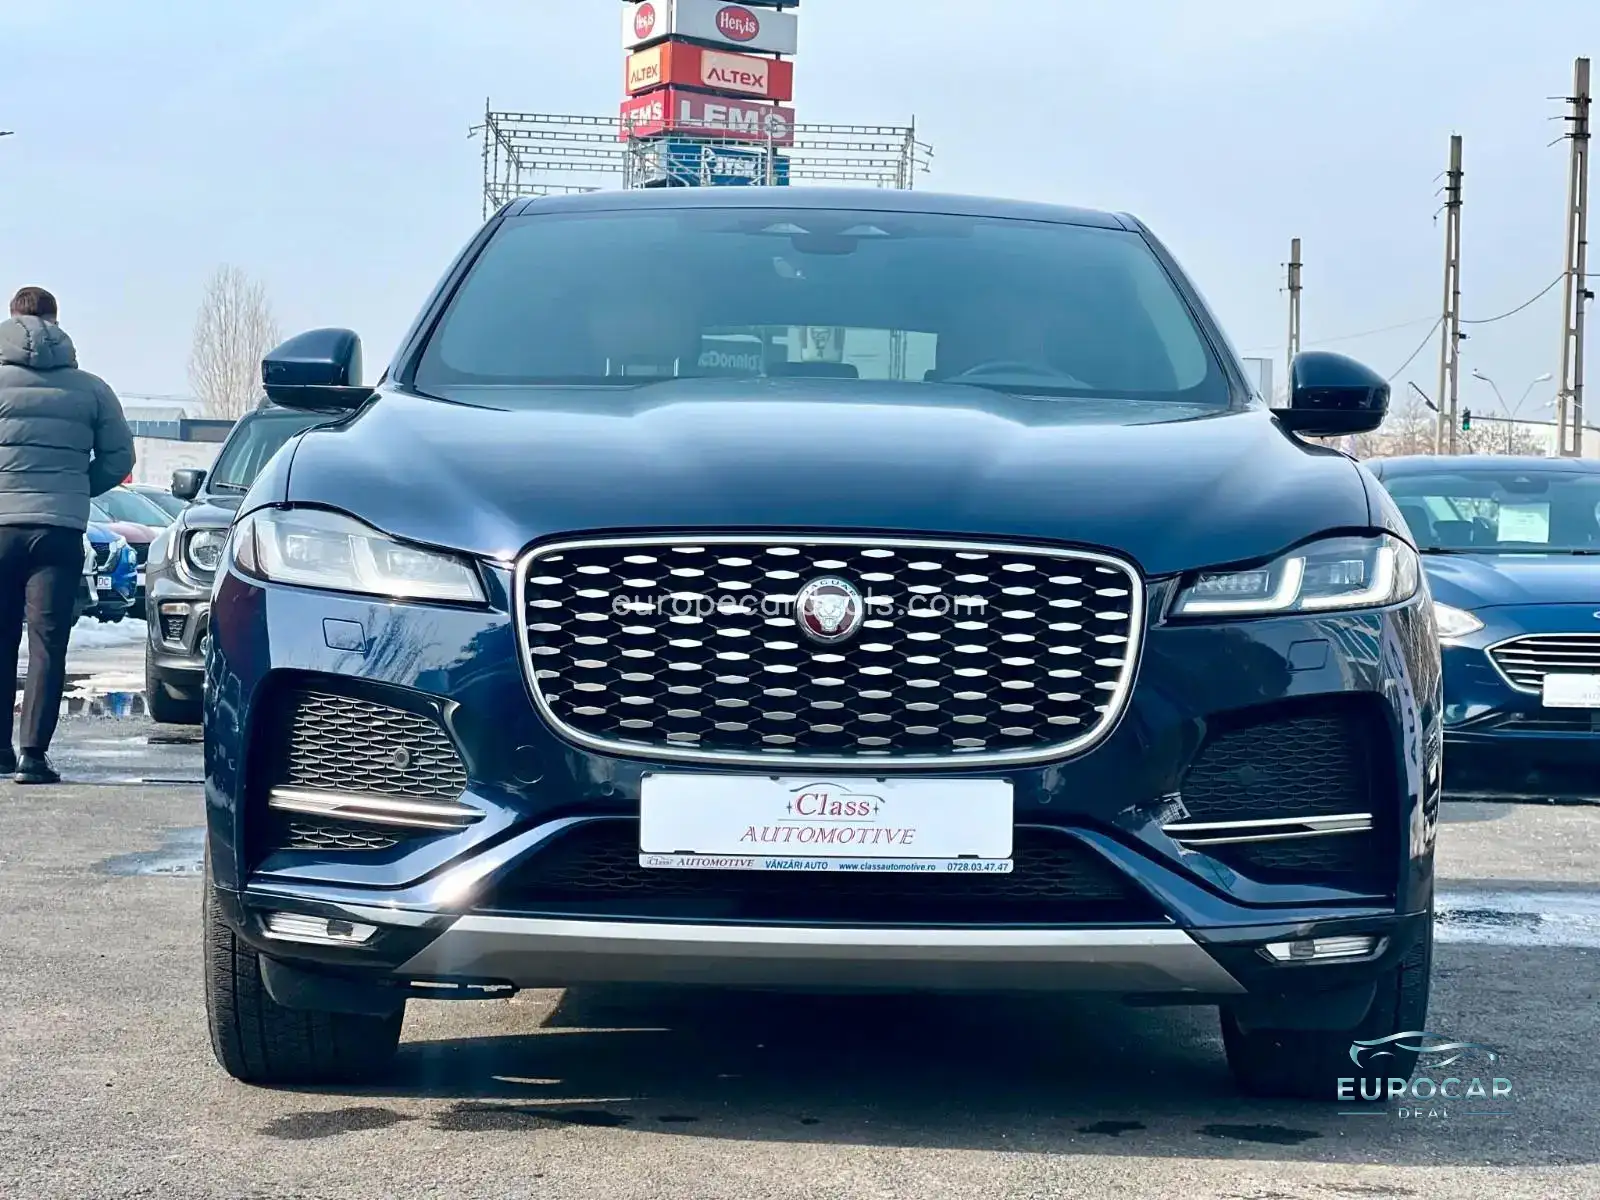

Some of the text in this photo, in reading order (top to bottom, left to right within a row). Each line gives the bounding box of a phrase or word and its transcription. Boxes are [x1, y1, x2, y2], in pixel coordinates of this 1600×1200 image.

[719, 12, 756, 34] Hervis
[802, 579, 857, 596] JAGUAR
[795, 793, 870, 816] Class
[739, 825, 916, 845] AUTOMOTIVE
[677, 857, 755, 867] AUTOMOTIVE
[804, 861, 828, 870] AUTO
[838, 862, 936, 872] www.classautomotive.ro
[947, 862, 1008, 872] 0728.03.47.47
